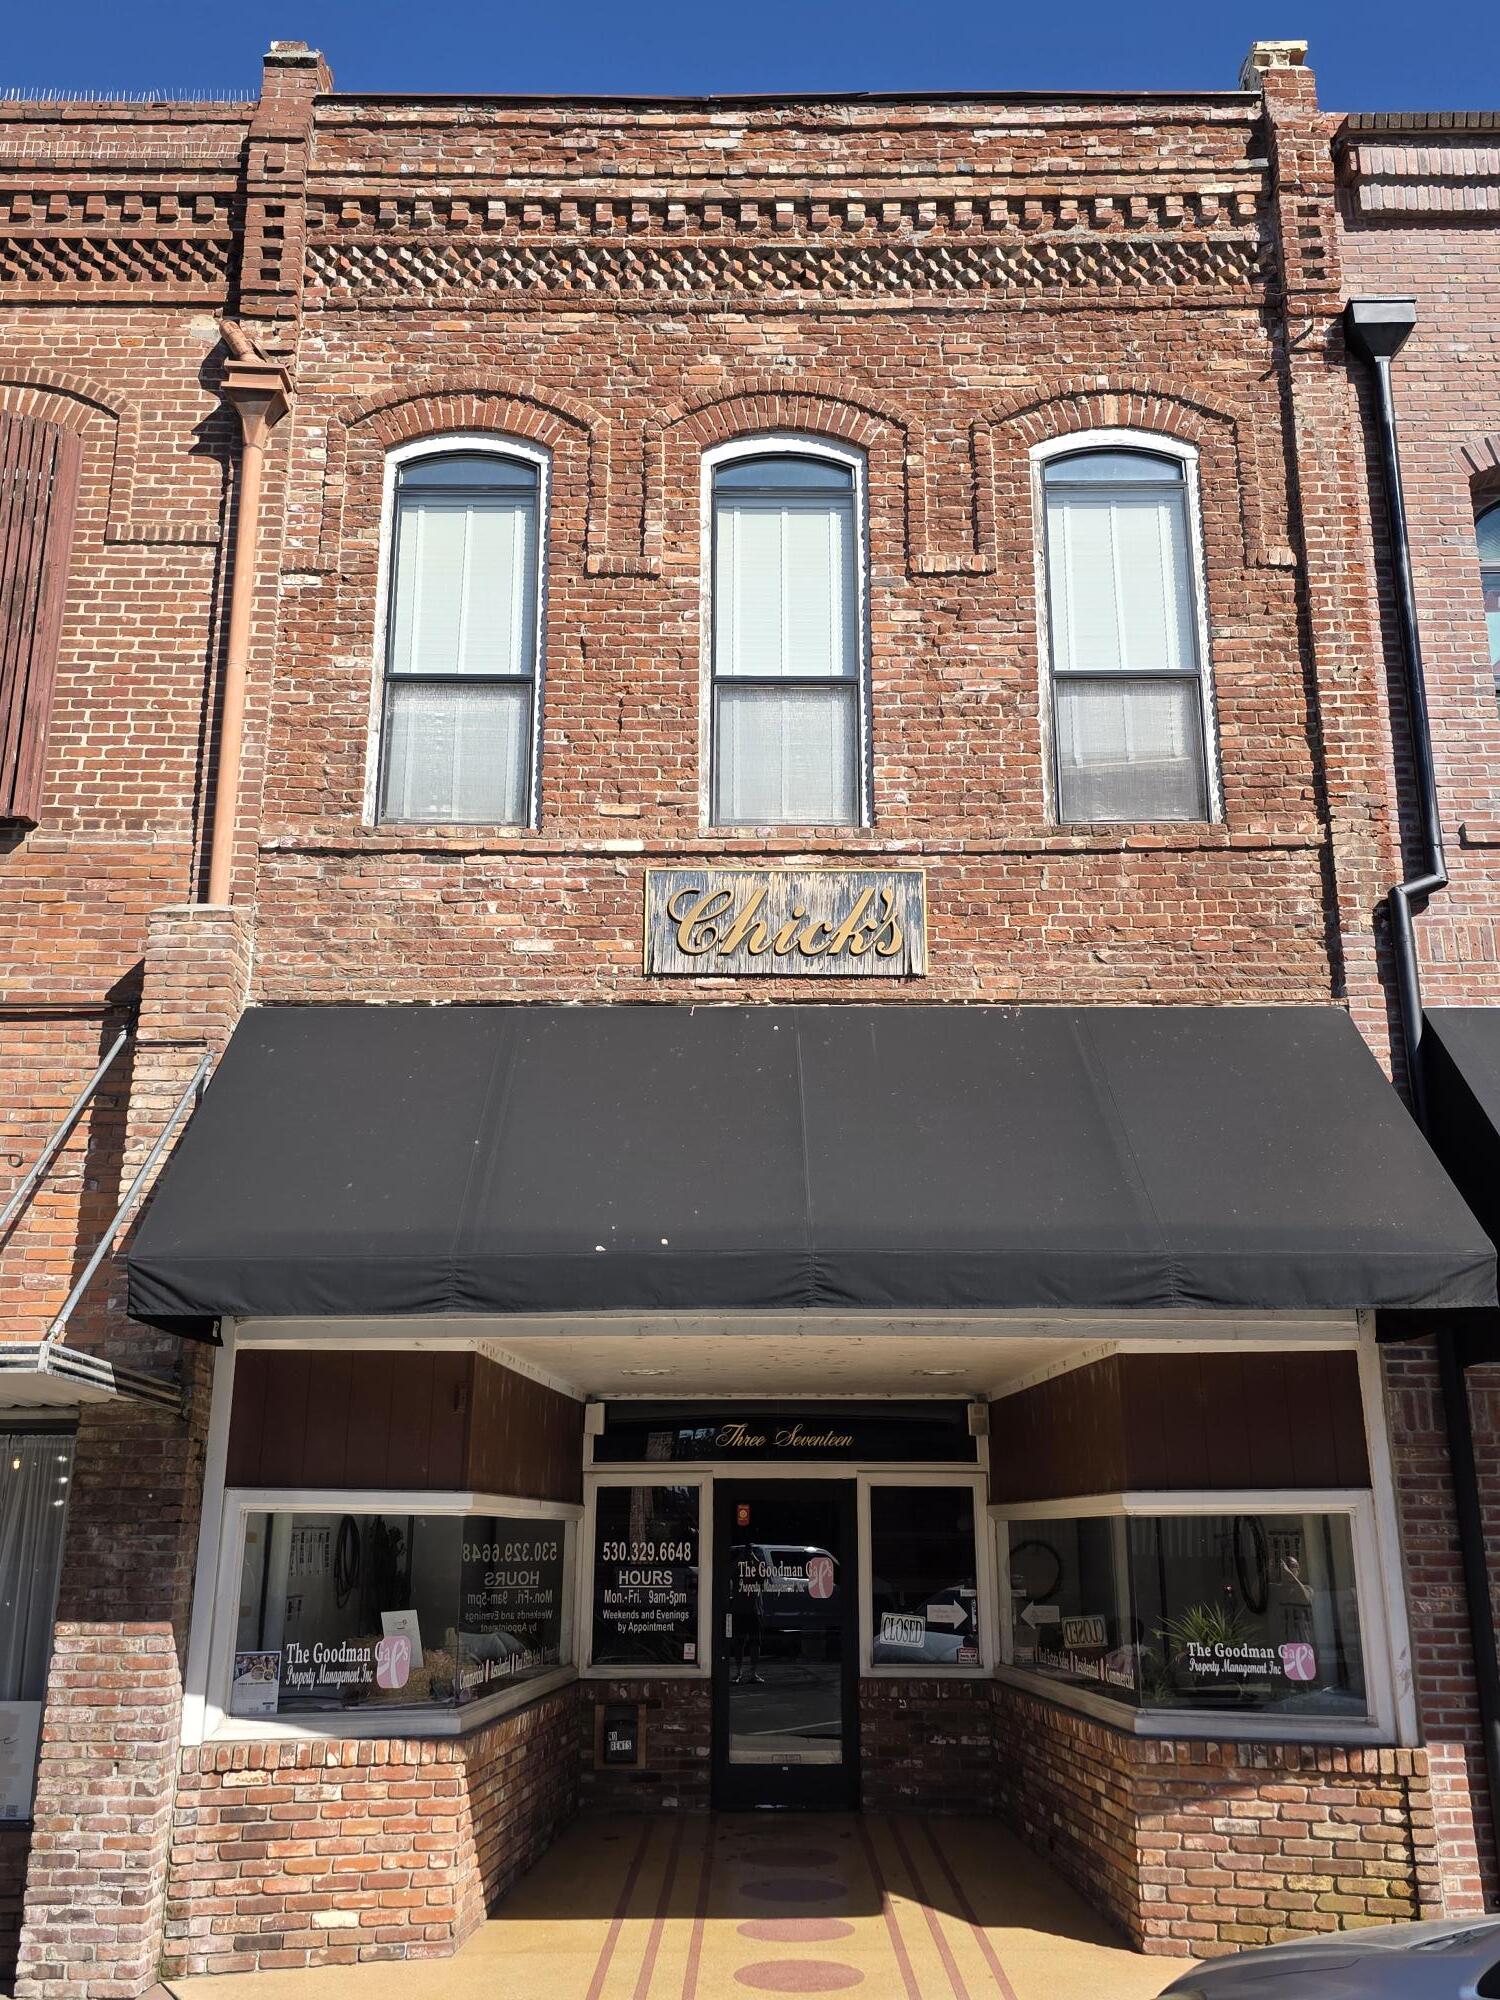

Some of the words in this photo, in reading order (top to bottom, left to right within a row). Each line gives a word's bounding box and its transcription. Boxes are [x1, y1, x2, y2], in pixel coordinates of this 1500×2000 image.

[667, 886, 904, 957] Chick's
[715, 1423, 766, 1447] Three
[773, 1423, 854, 1447] Seventeen
[602, 1541, 692, 1561] 530.329.6648
[618, 1570, 673, 1585] HOURS
[738, 1561, 757, 1577] The
[759, 1560, 803, 1577] Goodman
[648, 1590, 687, 1607] 9am-5pm
[602, 1608, 640, 1620] Weekends
[641, 1609, 655, 1620] and
[656, 1609, 689, 1622] Evenings
[617, 1622, 627, 1633] by
[628, 1622, 674, 1633] Appointment
[882, 1617, 924, 1645] CLOSED
[286, 1642, 310, 1664] The
[312, 1641, 372, 1664] Goodman
[1186, 1641, 1212, 1657] The
[1214, 1642, 1276, 1659] Goodman
[285, 1664, 316, 1691] Property
[316, 1663, 361, 1691] Management
[362, 1662, 374, 1684] Inc
[460, 1664, 484, 1690] Commercial
[1105, 1663, 1135, 1690] Commercial
[1188, 1658, 1220, 1677] Property
[1221, 1658, 1268, 1678] Management
[1269, 1660, 1282, 1675] Inc
